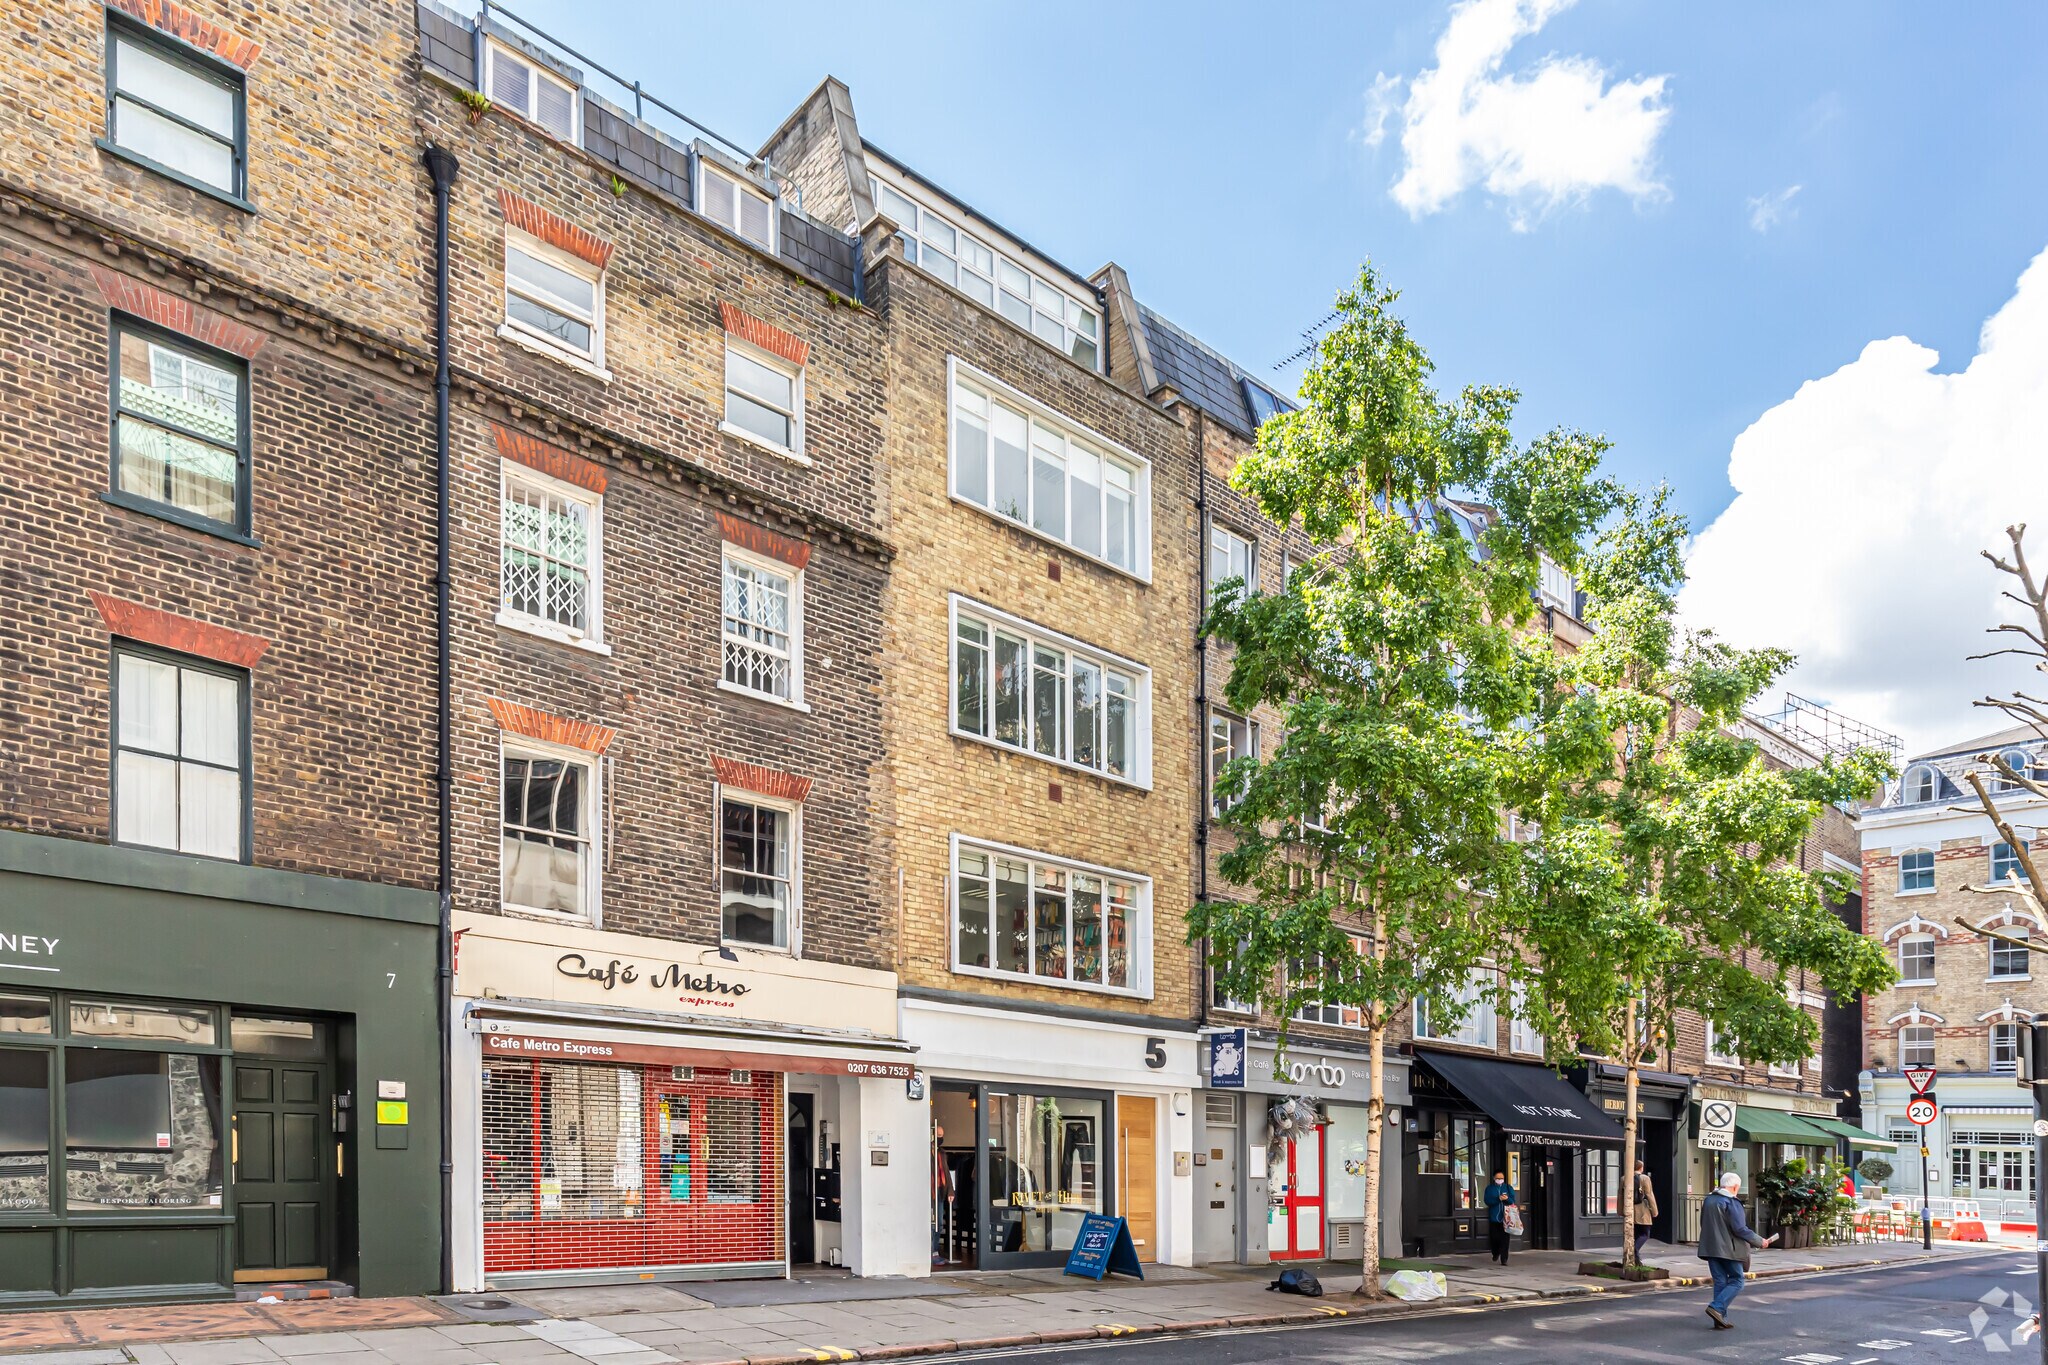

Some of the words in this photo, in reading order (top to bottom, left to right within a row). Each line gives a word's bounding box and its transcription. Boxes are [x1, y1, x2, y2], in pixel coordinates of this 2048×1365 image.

[0, 933, 60, 955] NEY
[386, 972, 396, 989] 7
[557, 953, 639, 990] Café
[650, 964, 751, 996] Metro
[679, 996, 735, 1008] express
[490, 1036, 520, 1049] Cafe
[524, 1039, 560, 1052] Metro
[563, 1041, 613, 1056] Express
[1145, 1038, 1167, 1068] 5
[847, 1063, 869, 1073] 0207
[870, 1065, 887, 1075] 636
[888, 1066, 909, 1076] 7525
[1512, 1104, 1542, 1116] HOT
[1540, 1106, 1581, 1119] STONE
[1912, 1106, 1933, 1118] 20
[1511, 1134, 1524, 1143] HOT
[1524, 1135, 1543, 1145] STONE
[1702, 1138, 1730, 1148] ENDS
[1012, 1191, 1043, 1206] RIVET
